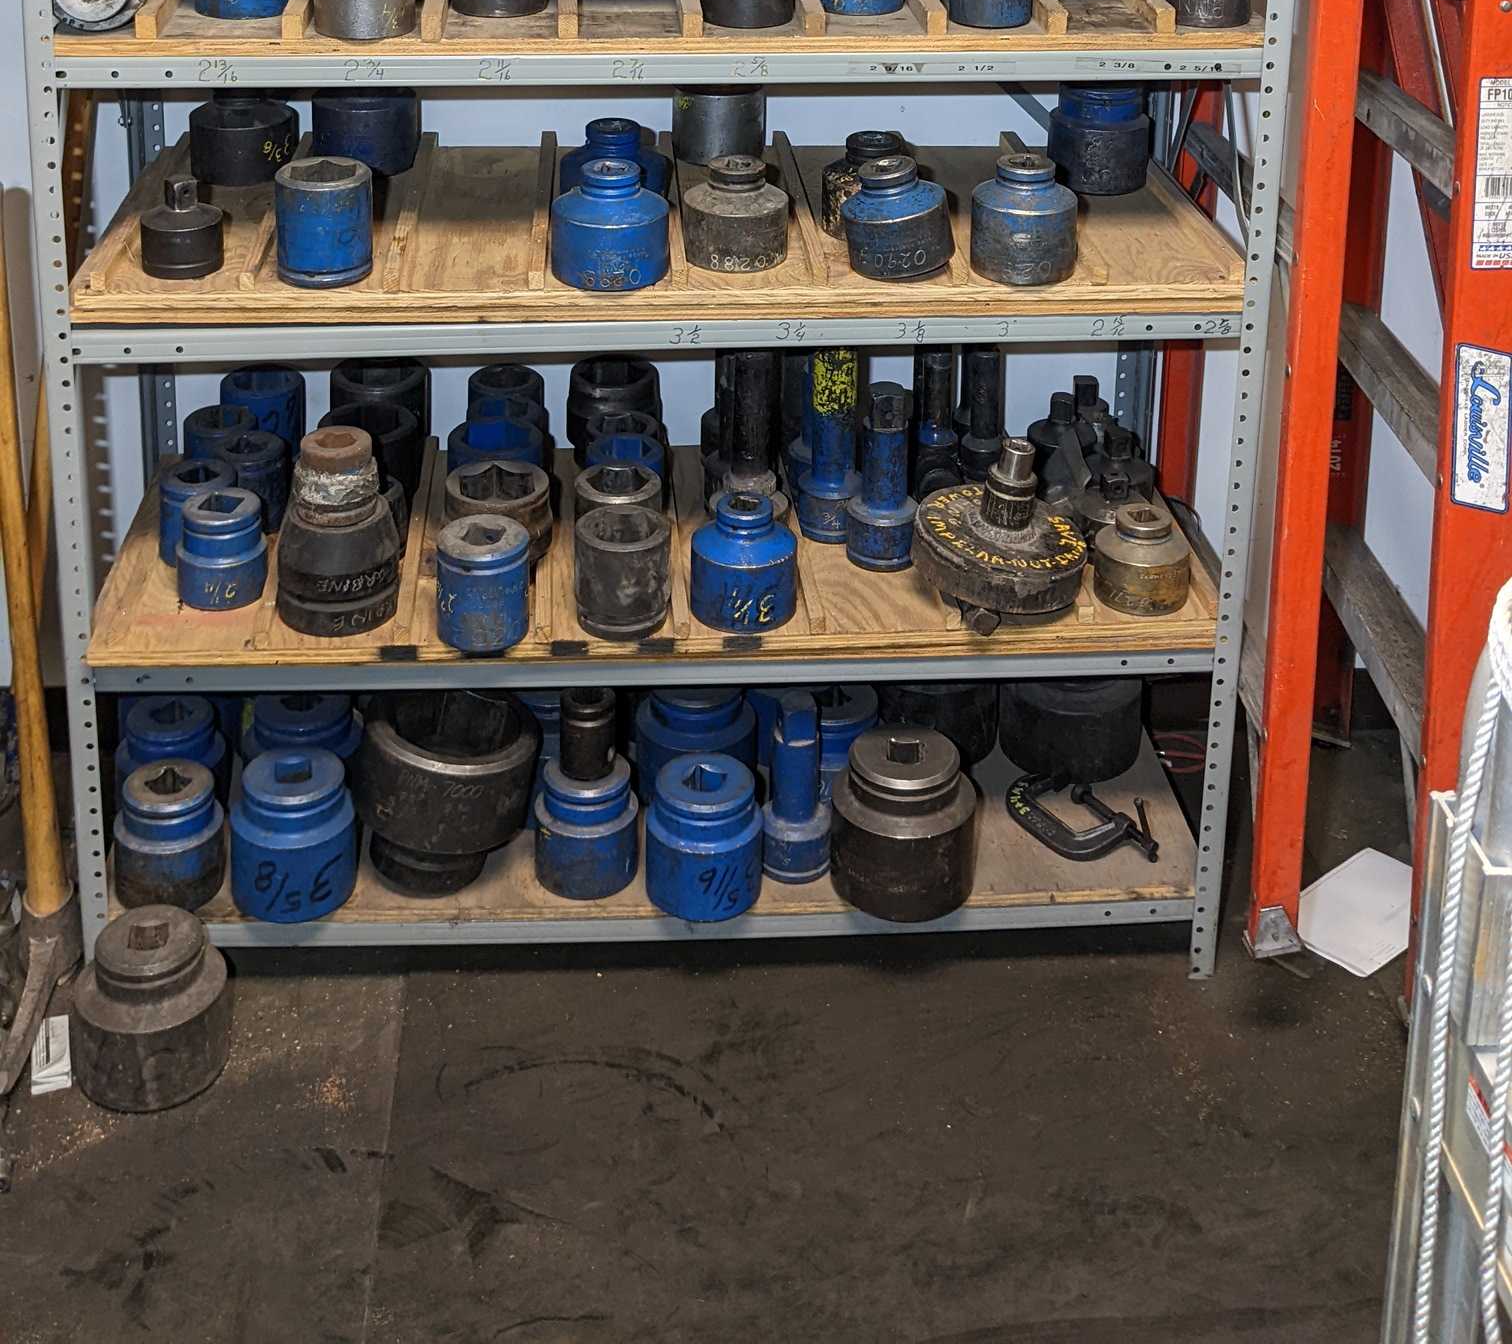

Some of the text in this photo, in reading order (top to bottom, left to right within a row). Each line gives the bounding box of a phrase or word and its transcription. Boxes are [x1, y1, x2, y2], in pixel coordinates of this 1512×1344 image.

[198, 58, 239, 84] 2 13/16
[343, 58, 359, 81] 2
[478, 59, 493, 81] 2
[612, 60, 627, 80] 2
[975, 64, 995, 72] 1/2
[1113, 61, 1135, 69] 3/8
[669, 327, 684, 345] 3
[775, 322, 790, 340] 3
[896, 322, 906, 340] 3
[1091, 318, 1104, 337] 2
[1204, 319, 1217, 335] 2
[1467, 360, 1502, 484] Louisville
[254, 853, 343, 914] 3 5/8
